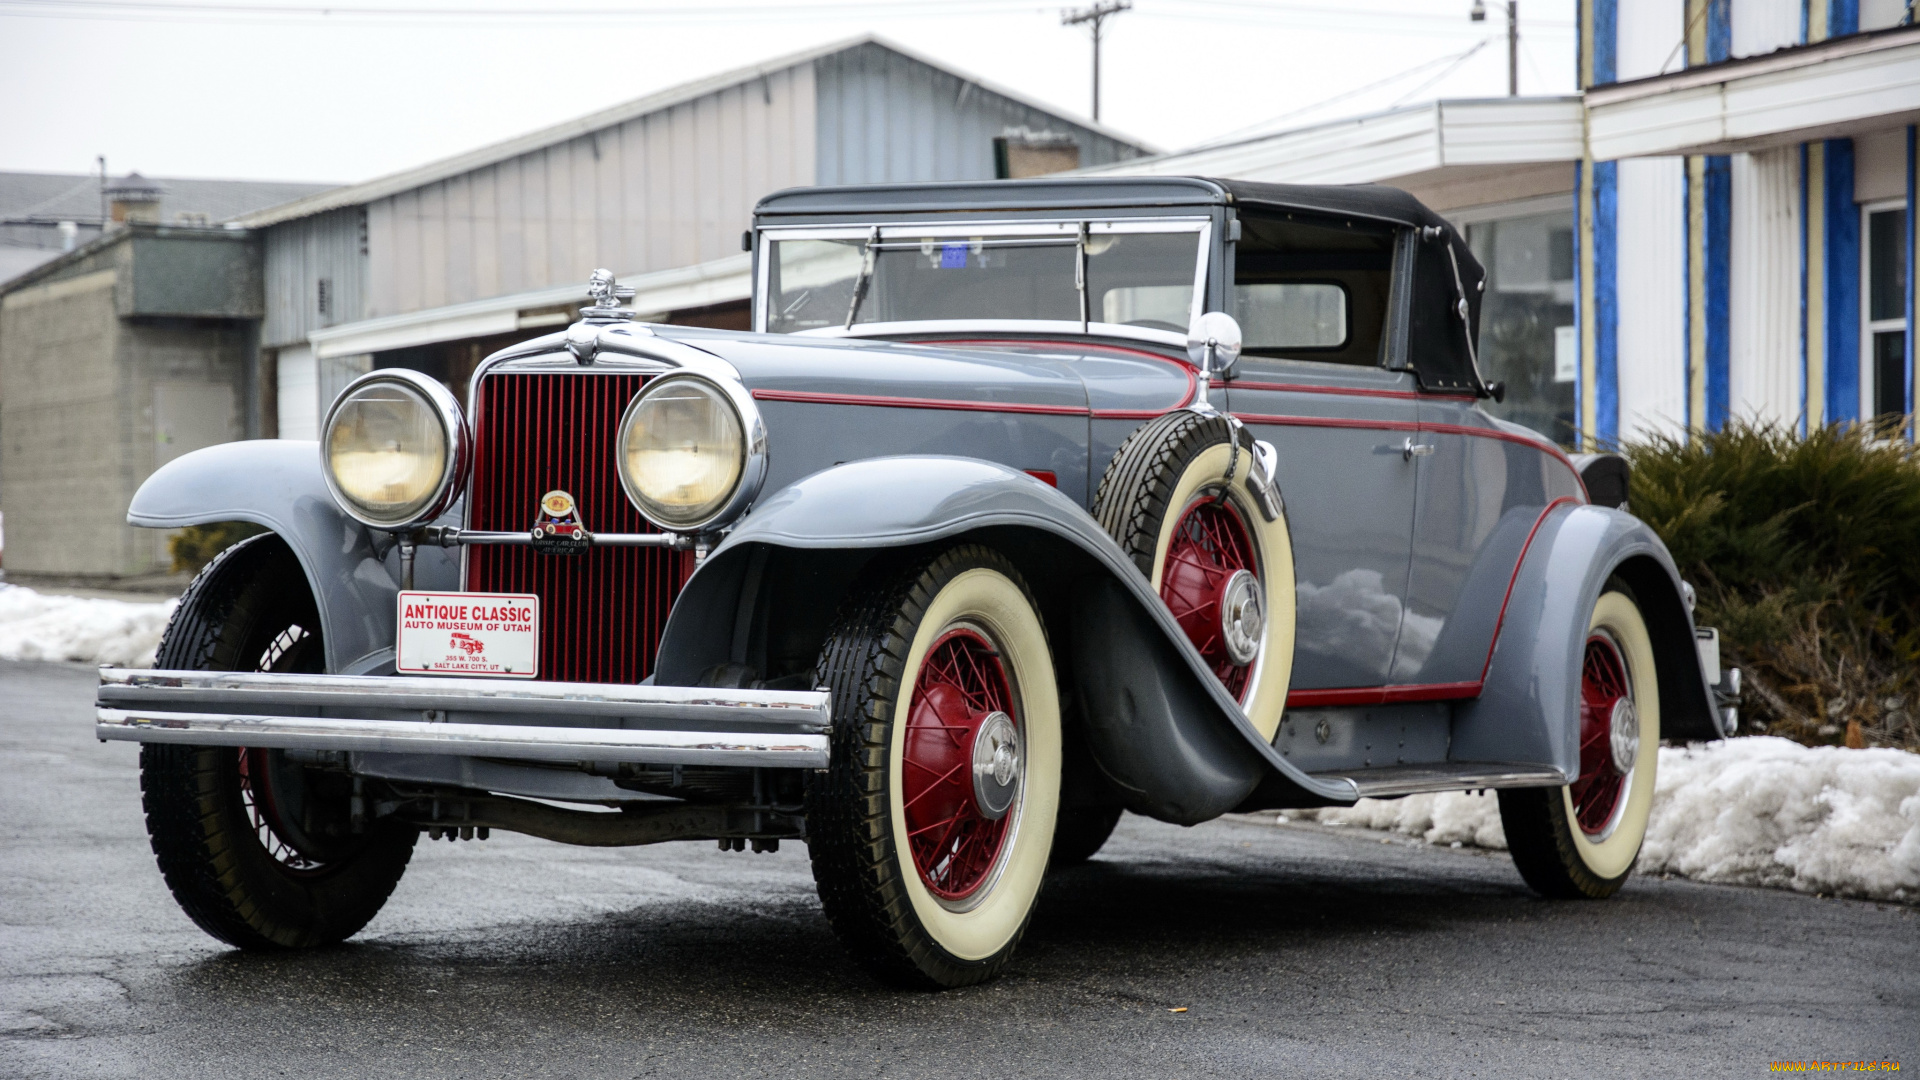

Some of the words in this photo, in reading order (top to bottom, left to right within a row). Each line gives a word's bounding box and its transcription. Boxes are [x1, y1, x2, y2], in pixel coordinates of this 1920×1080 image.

[405, 604, 467, 620] ANTIQUE
[472, 606, 531, 622] CLASSIC
[404, 621, 434, 629] AUTO
[437, 622, 483, 631] MUSEUM
[486, 623, 499, 631] OF
[503, 623, 531, 632] UTAH
[452, 662, 469, 670] LAKE
[471, 663, 489, 671] CITY,
